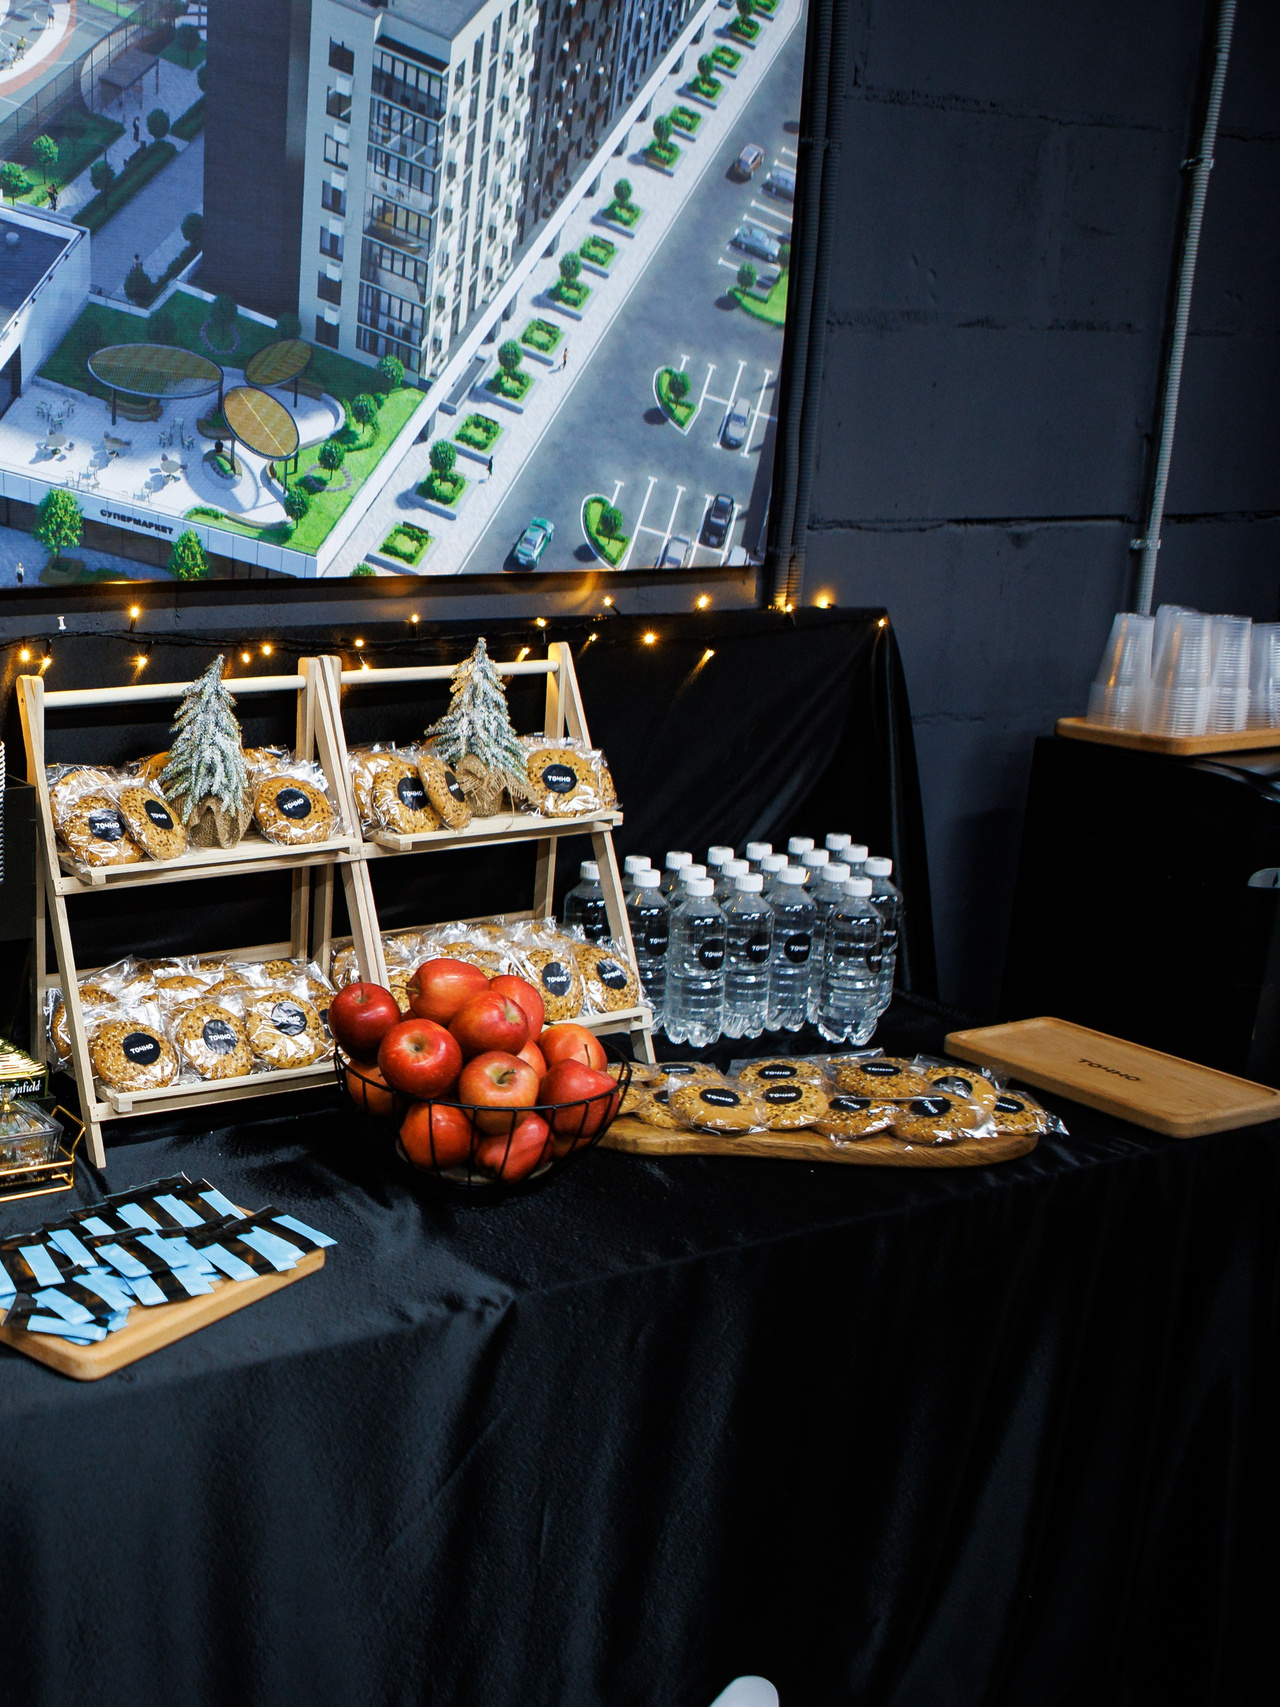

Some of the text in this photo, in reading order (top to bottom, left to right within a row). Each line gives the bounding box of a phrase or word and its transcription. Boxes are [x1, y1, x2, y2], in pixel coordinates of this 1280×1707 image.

[100, 509, 174, 535] СУПЕРМАРКЕТ
[283, 798, 305, 811] ТОЧНО
[95, 821, 120, 830] ТОЧНО
[130, 1043, 154, 1054] ТОЧНО
[1078, 1058, 1141, 1082] ТОЧНО
